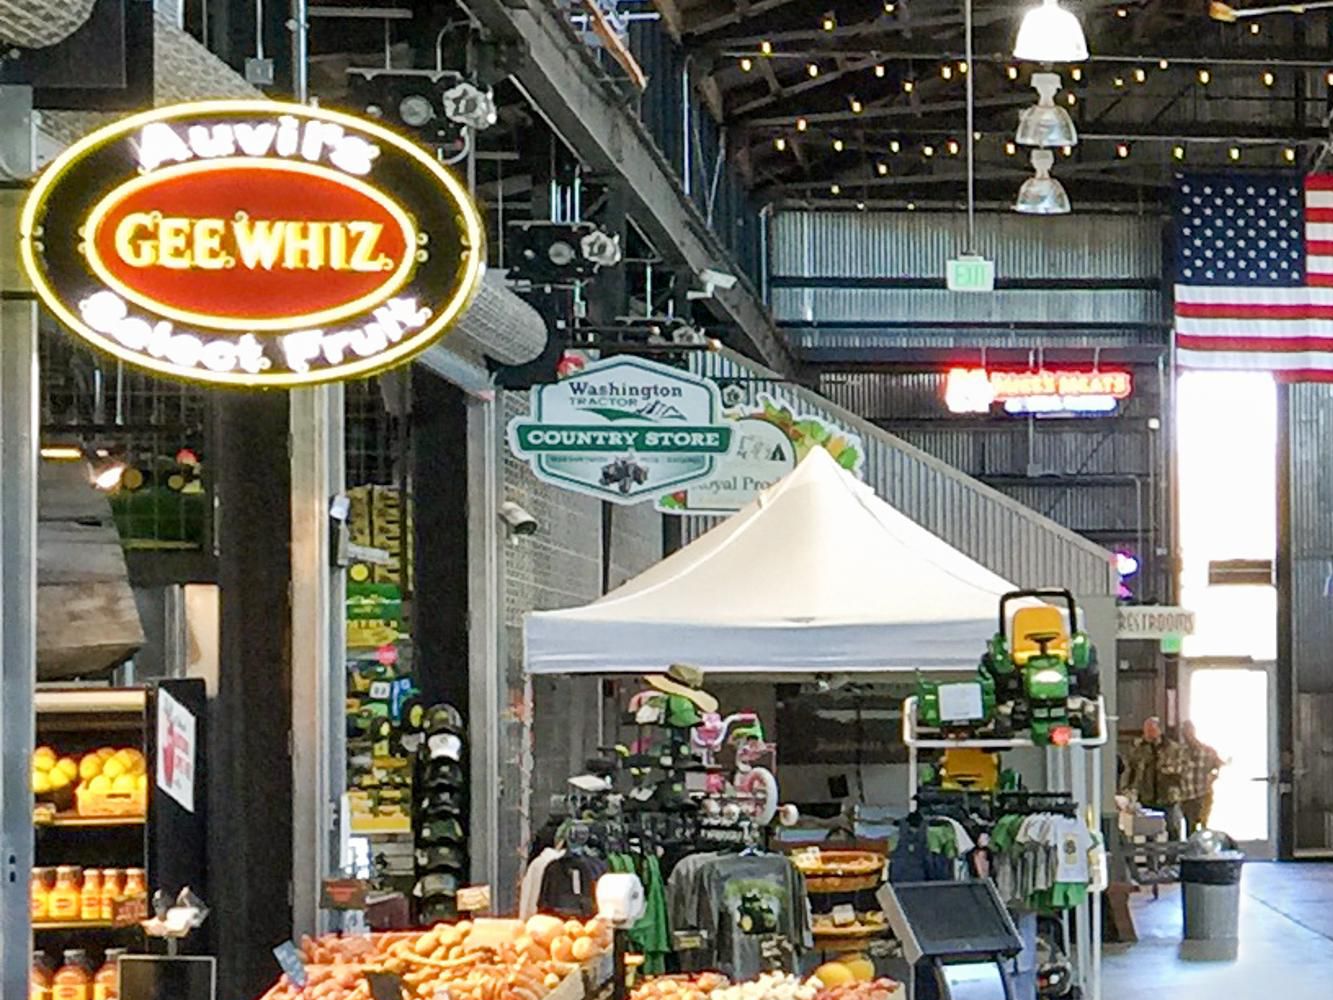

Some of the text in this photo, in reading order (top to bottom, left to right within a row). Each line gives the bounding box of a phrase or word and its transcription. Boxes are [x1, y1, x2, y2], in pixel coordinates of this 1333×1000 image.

[136, 117, 380, 175] Auvil's
[114, 212, 390, 271] GEE WHIZ
[79, 291, 432, 373] Select Fruit
[569, 382, 683, 401] Washington
[570, 397, 638, 407] TRACTOR
[527, 430, 720, 447] COUNTRY STORE
